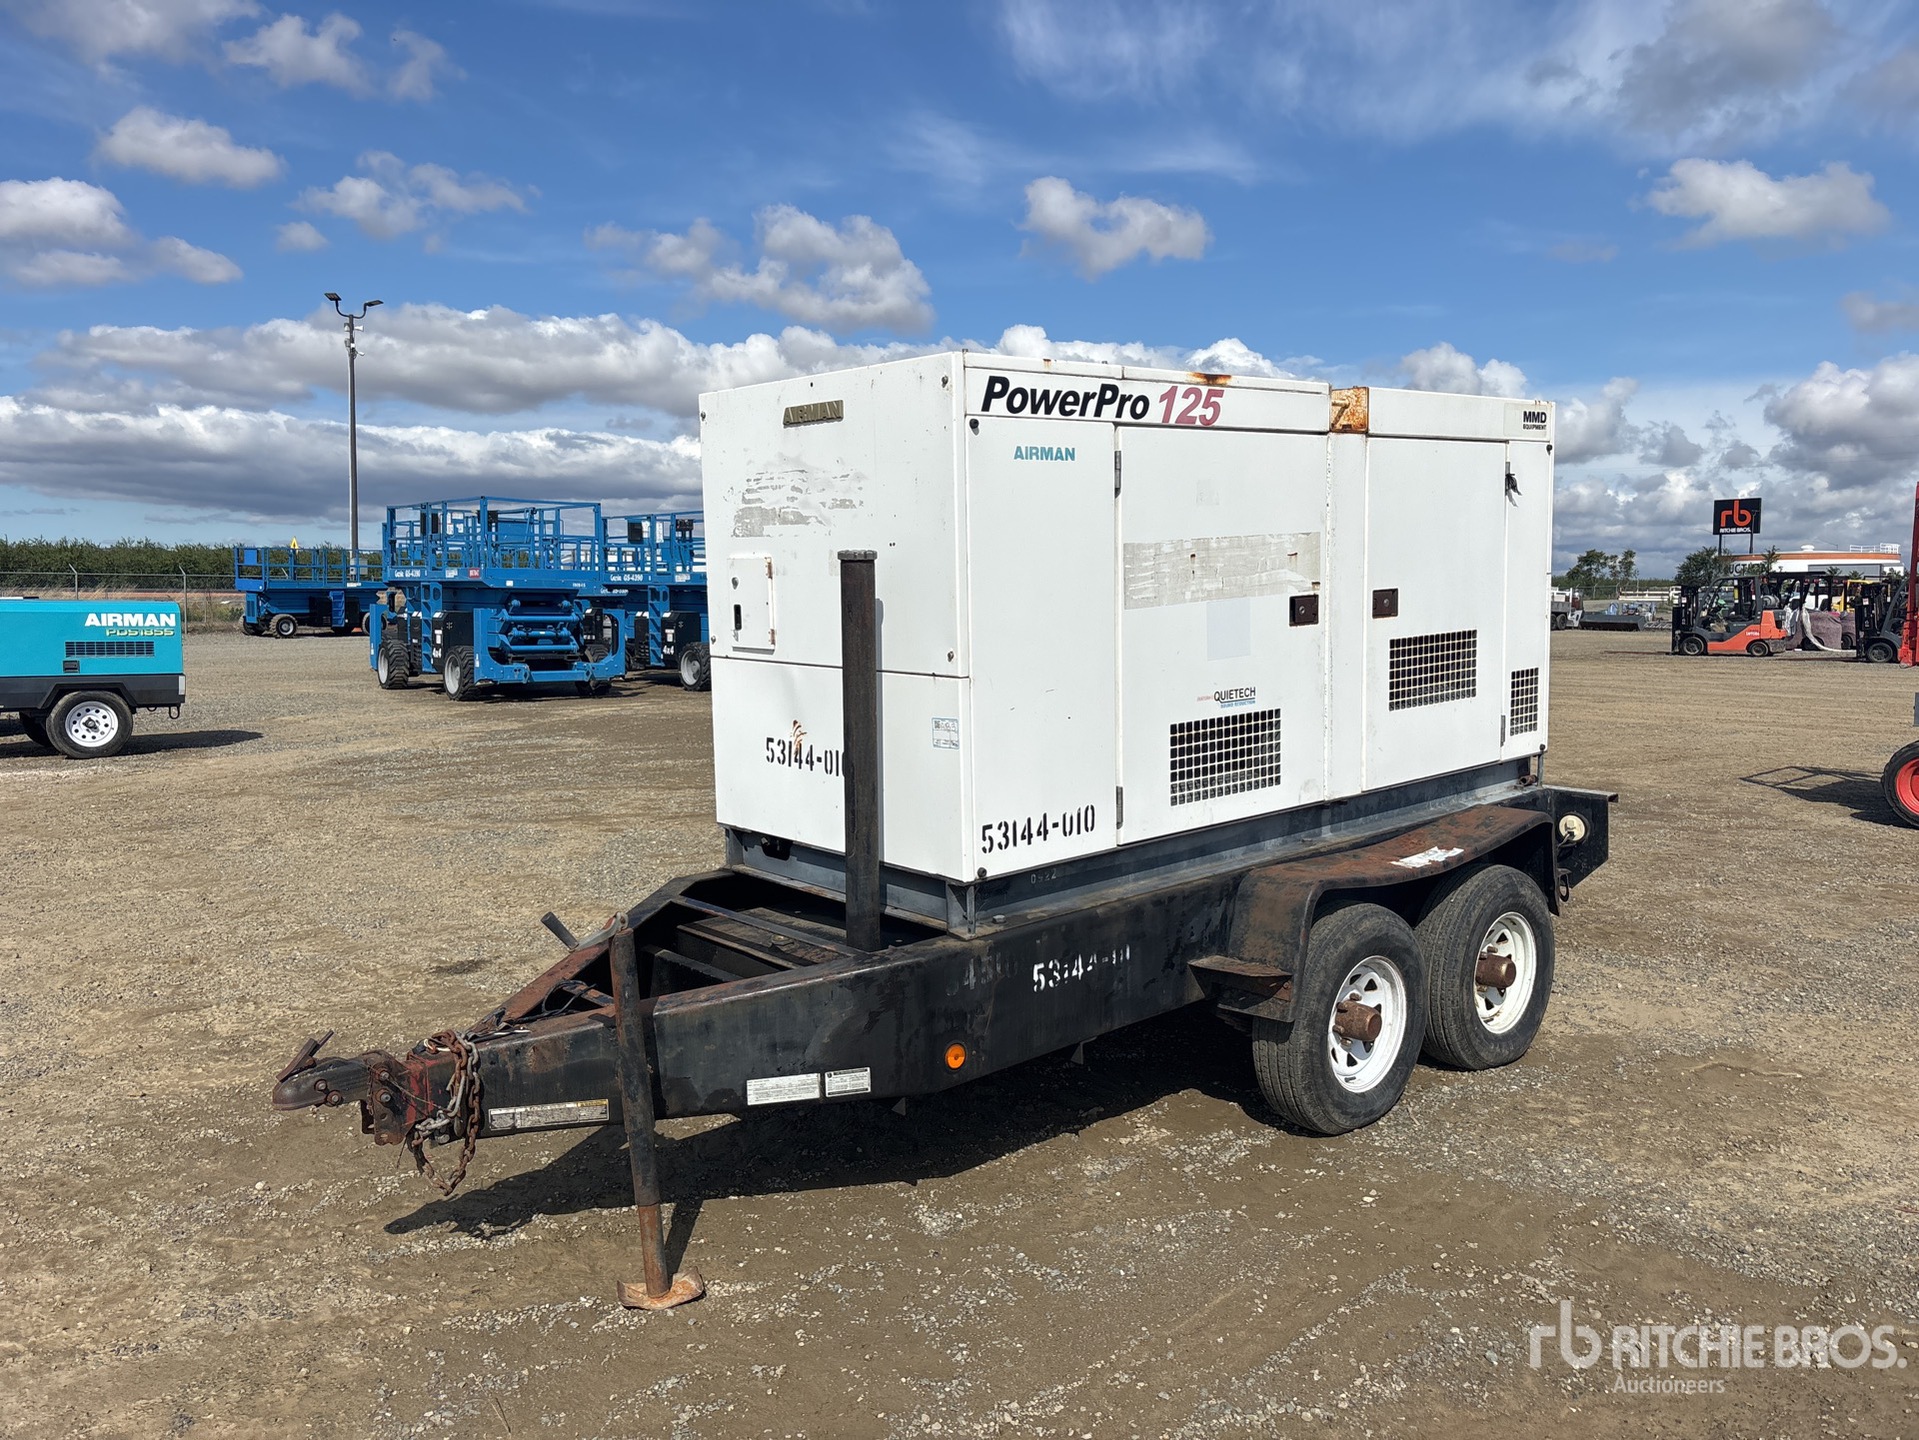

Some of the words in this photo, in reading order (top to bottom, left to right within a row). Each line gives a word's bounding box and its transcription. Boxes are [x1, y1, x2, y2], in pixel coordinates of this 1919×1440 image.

[782, 400, 843, 425] AIRMAN
[981, 375, 1150, 420] PowerPro
[1158, 385, 1225, 426] 125
[1523, 410, 1547, 423] MMD
[1013, 445, 1076, 461] AIRMAN
[1720, 500, 1752, 527] rb
[84, 613, 176, 627] AIRMAN
[1214, 686, 1256, 703] QUIETECH
[766, 737, 845, 777] 53144-01
[981, 804, 1096, 854] 53144-010
